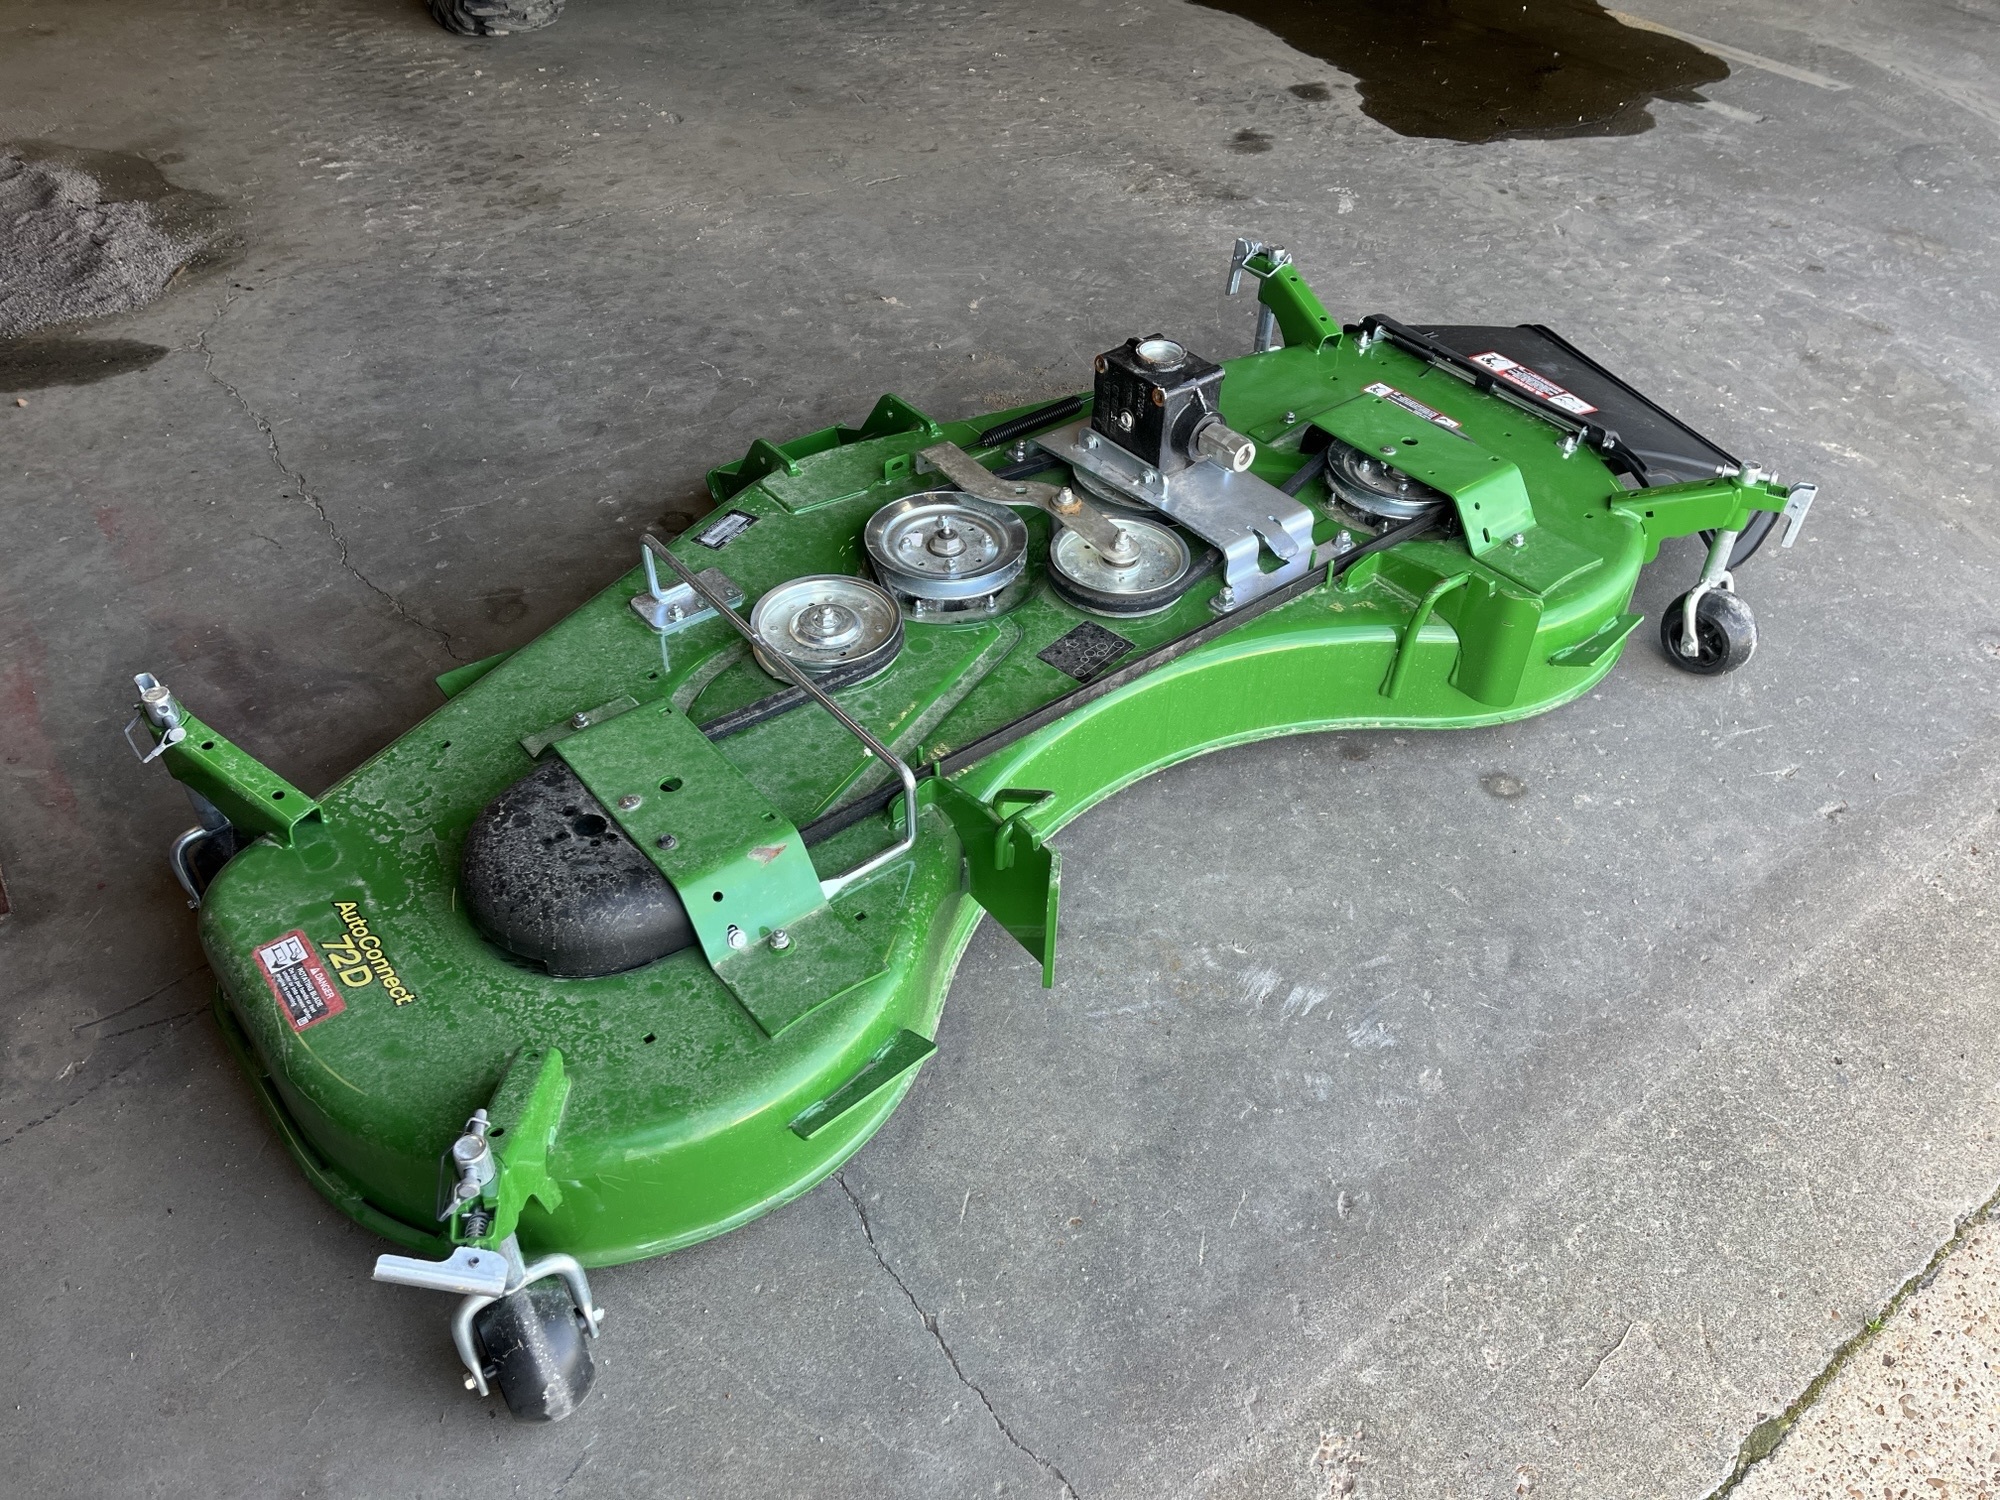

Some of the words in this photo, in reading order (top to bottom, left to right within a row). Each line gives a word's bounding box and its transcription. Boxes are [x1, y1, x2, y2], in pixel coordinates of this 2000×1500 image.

[321, 934, 373, 988] 72D
[333, 901, 416, 1006] AutoConnect
[297, 967, 314, 991] ROTATING
[310, 990, 324, 1007] BLADE
[314, 972, 335, 999] DANGER
